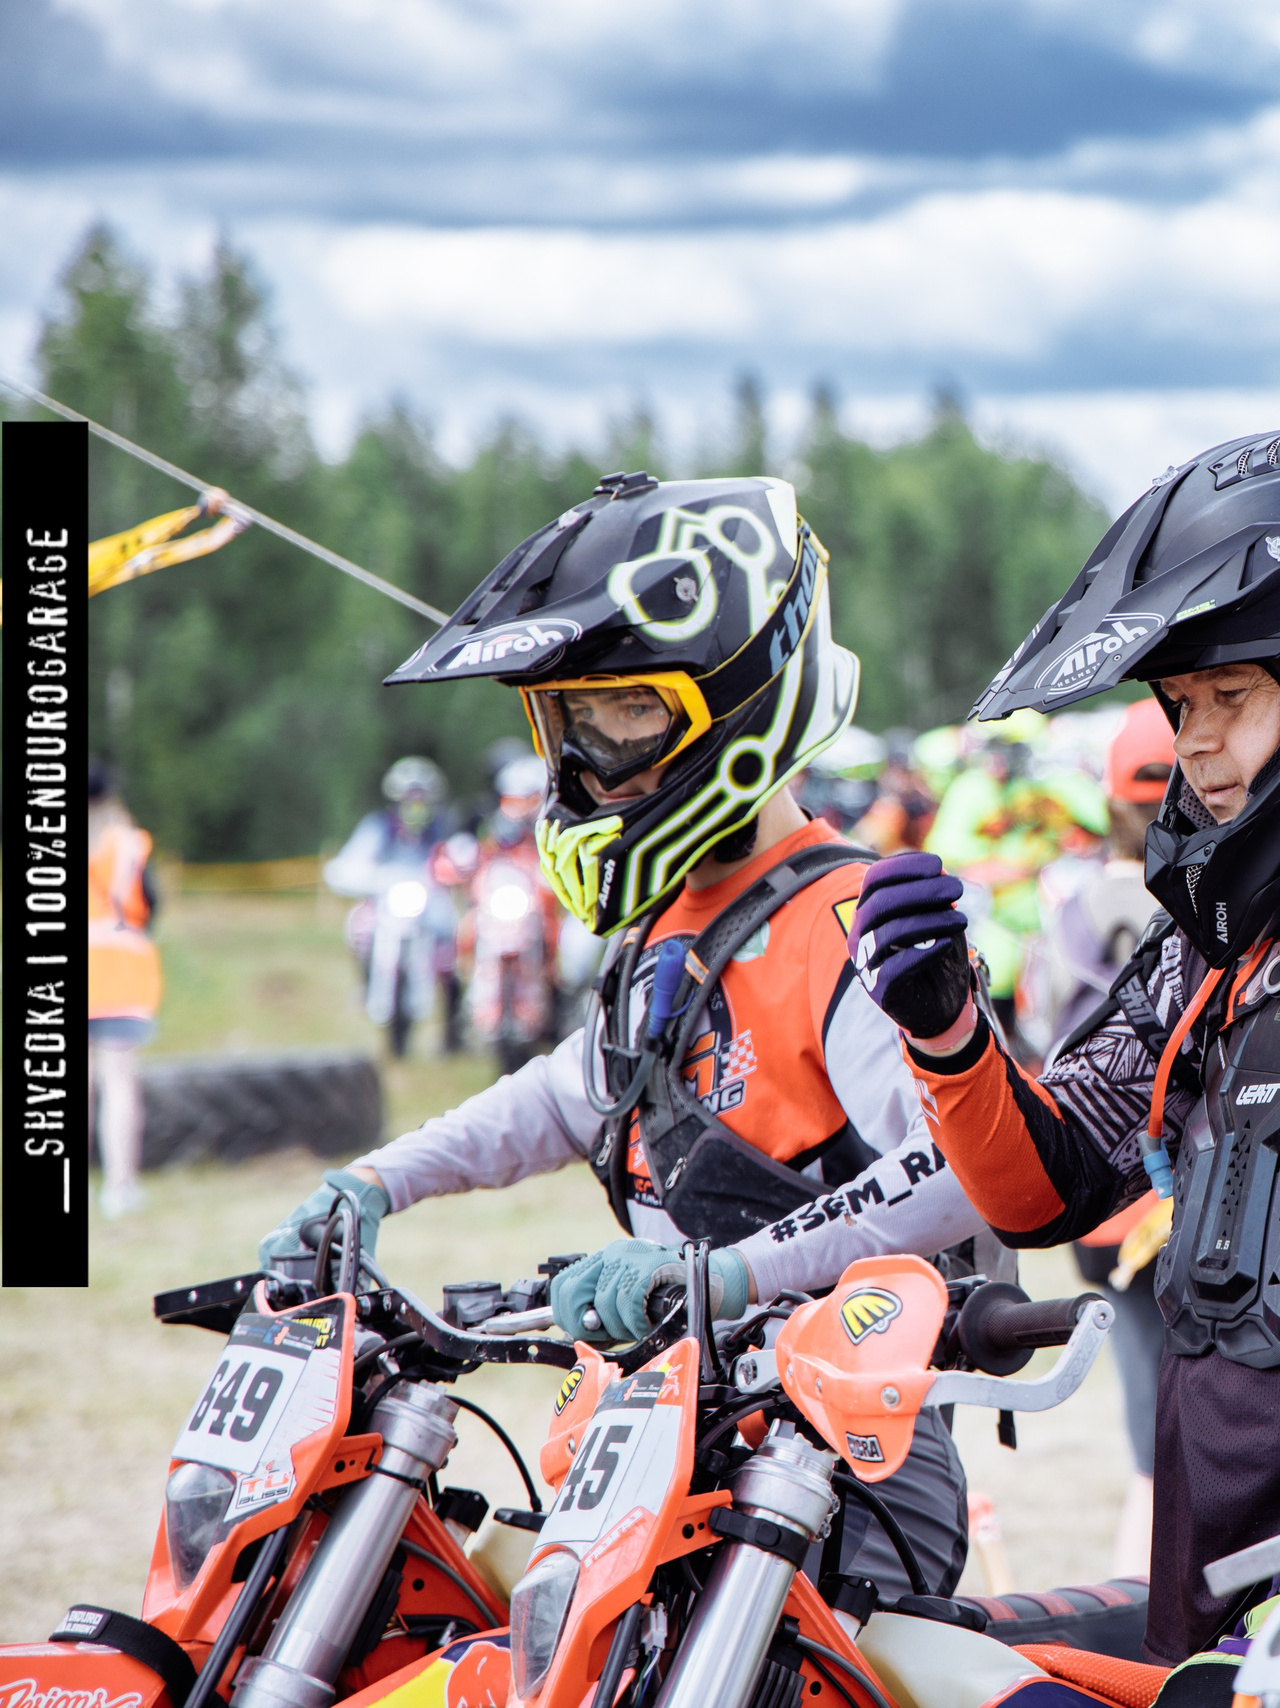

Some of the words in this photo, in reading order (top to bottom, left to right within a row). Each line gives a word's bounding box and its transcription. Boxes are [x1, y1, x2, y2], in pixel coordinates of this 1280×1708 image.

[1215, 901, 1228, 944] AIROH
[1119, 974, 1162, 1026] EATT
[1215, 1239, 1231, 1250] 6.5
[187, 1359, 284, 1443] 649
[559, 1425, 634, 1513] 45
[238, 1487, 289, 1506] BLISS
